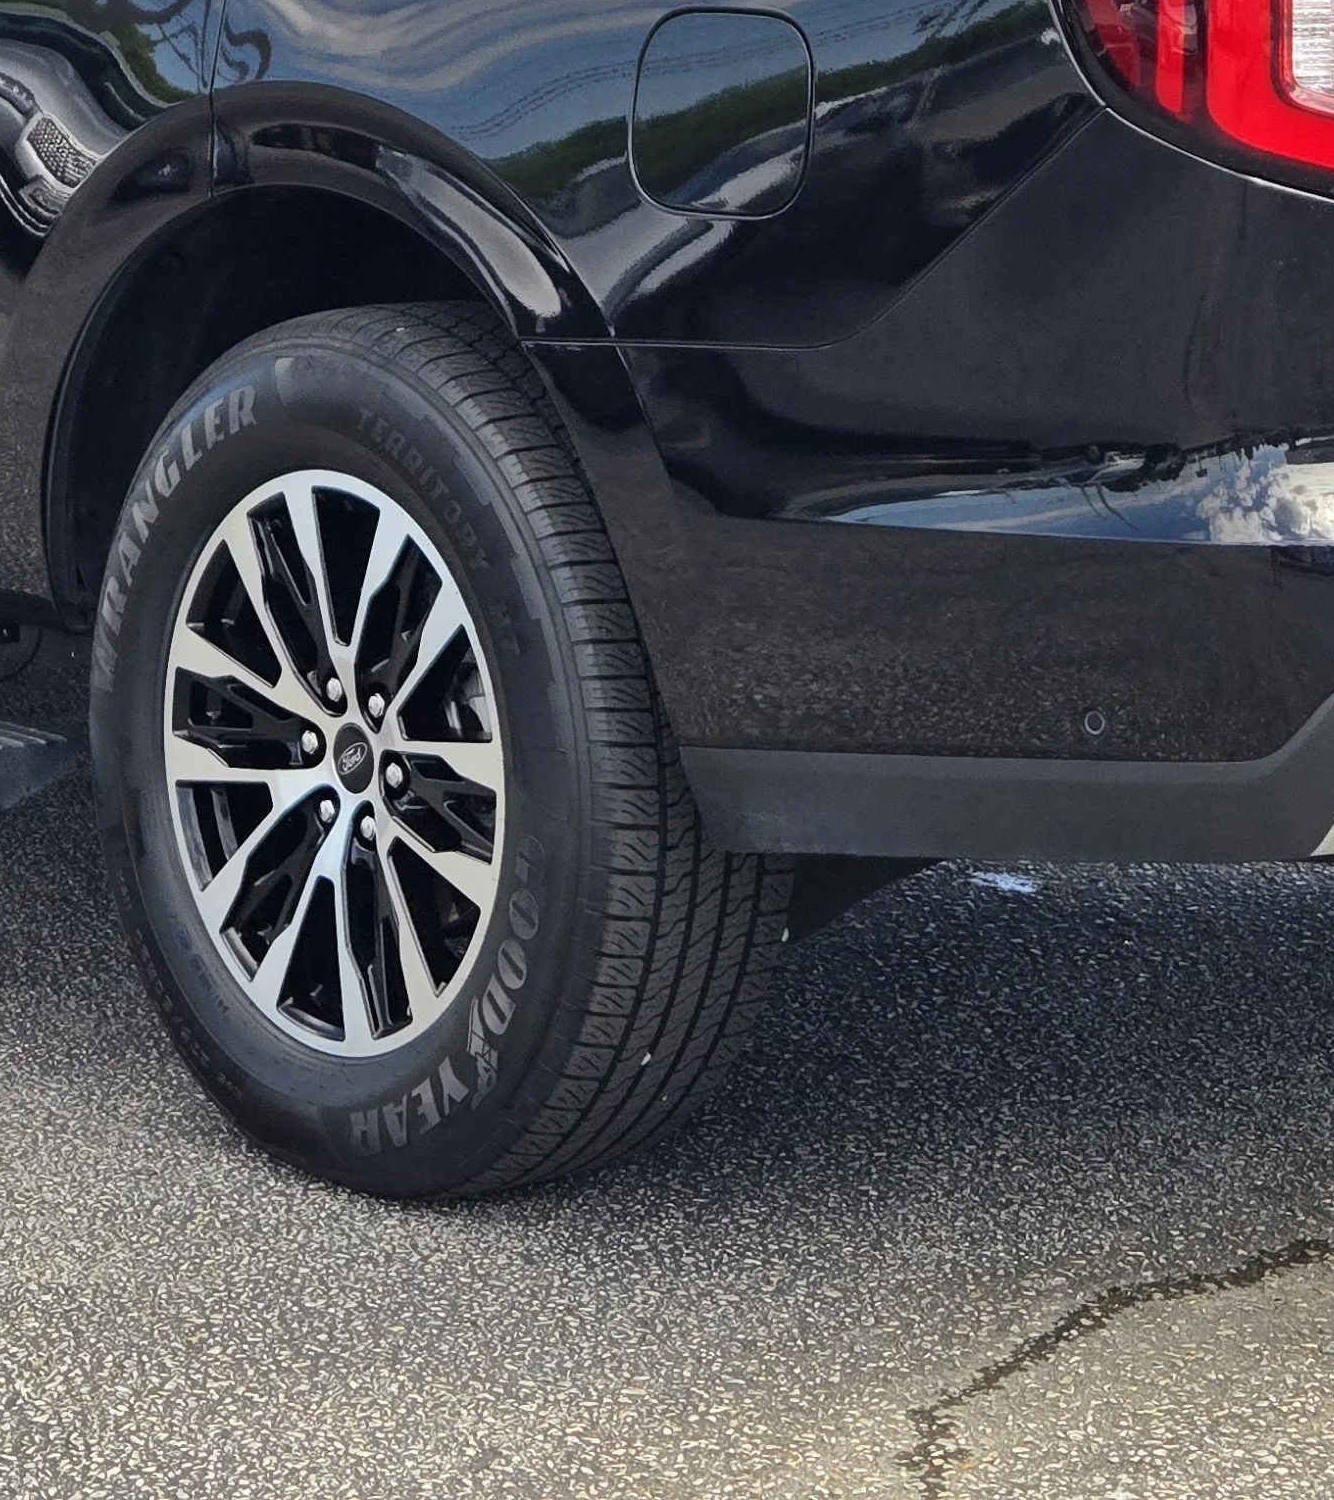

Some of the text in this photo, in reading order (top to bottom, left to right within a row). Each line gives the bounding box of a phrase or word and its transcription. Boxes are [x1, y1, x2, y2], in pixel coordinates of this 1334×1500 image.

[92, 383, 258, 693] WRANGLER
[357, 407, 491, 571] TERRITORY
[349, 834, 548, 1155] GOODYEAR
